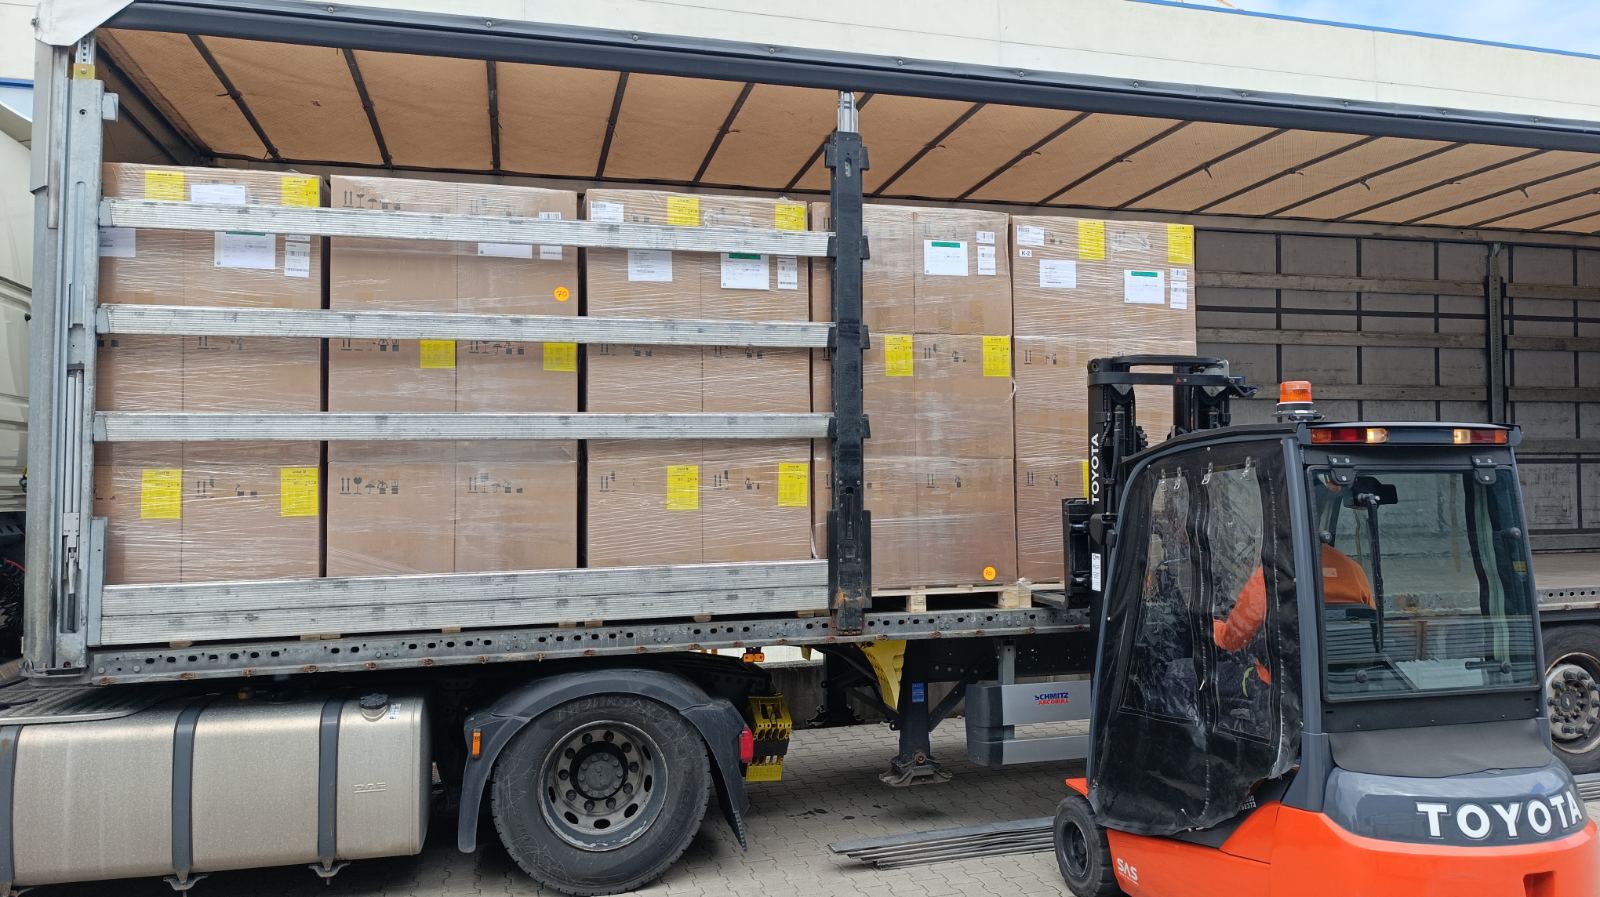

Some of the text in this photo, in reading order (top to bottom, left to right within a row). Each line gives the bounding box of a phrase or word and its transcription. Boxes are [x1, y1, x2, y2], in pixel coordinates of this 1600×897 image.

[1091, 433, 1099, 506] TOYOTA
[1034, 692, 1068, 701] SCHMITZ
[1416, 791, 1582, 839] TOYOTA
[1117, 857, 1138, 881] SAS
